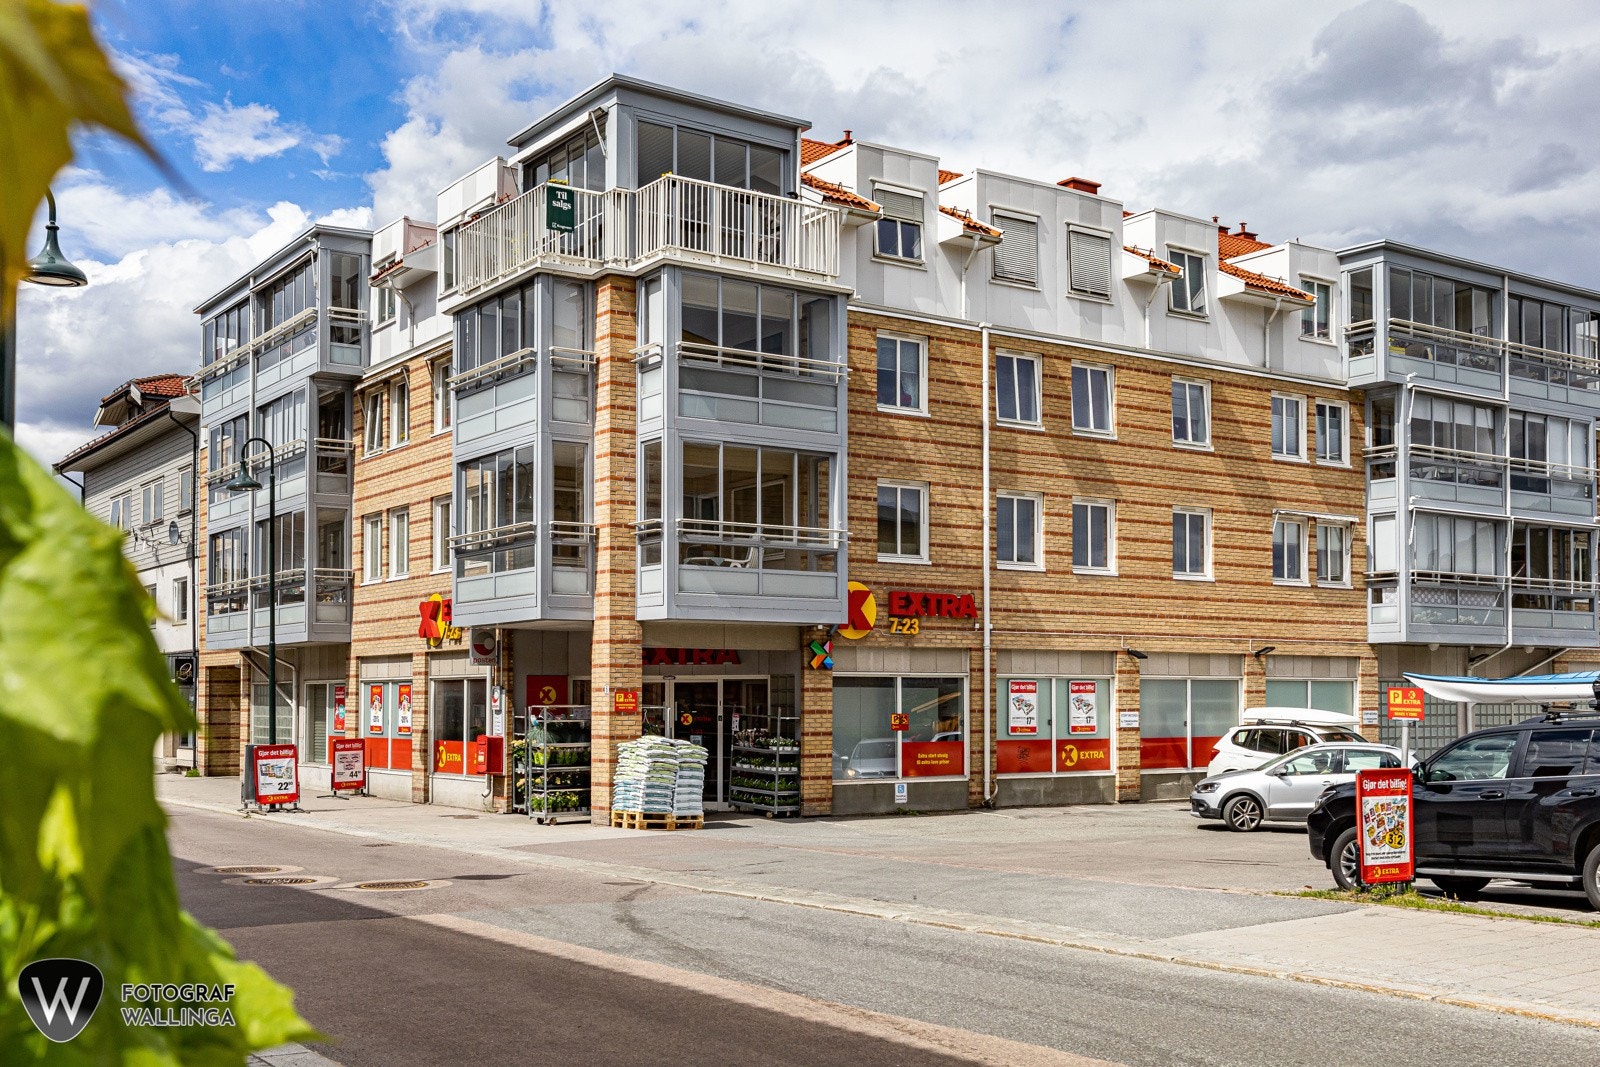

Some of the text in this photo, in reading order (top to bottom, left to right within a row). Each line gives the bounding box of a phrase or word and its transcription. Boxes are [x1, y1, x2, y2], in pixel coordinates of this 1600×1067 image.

[556, 191, 567, 200] Til
[552, 200, 572, 210] salgs
[888, 591, 978, 617] EXTRA
[889, 618, 919, 634] 7-23
[1393, 692, 1400, 702] P
[447, 753, 461, 762] EXTRA
[1080, 750, 1104, 759] EXTRA
[349, 771, 359, 779] 44
[277, 782, 288, 791] 22
[1363, 778, 1407, 791] Gjør det billig!
[1397, 835, 1403, 845] 2
[1382, 867, 1399, 875] EXTRA
